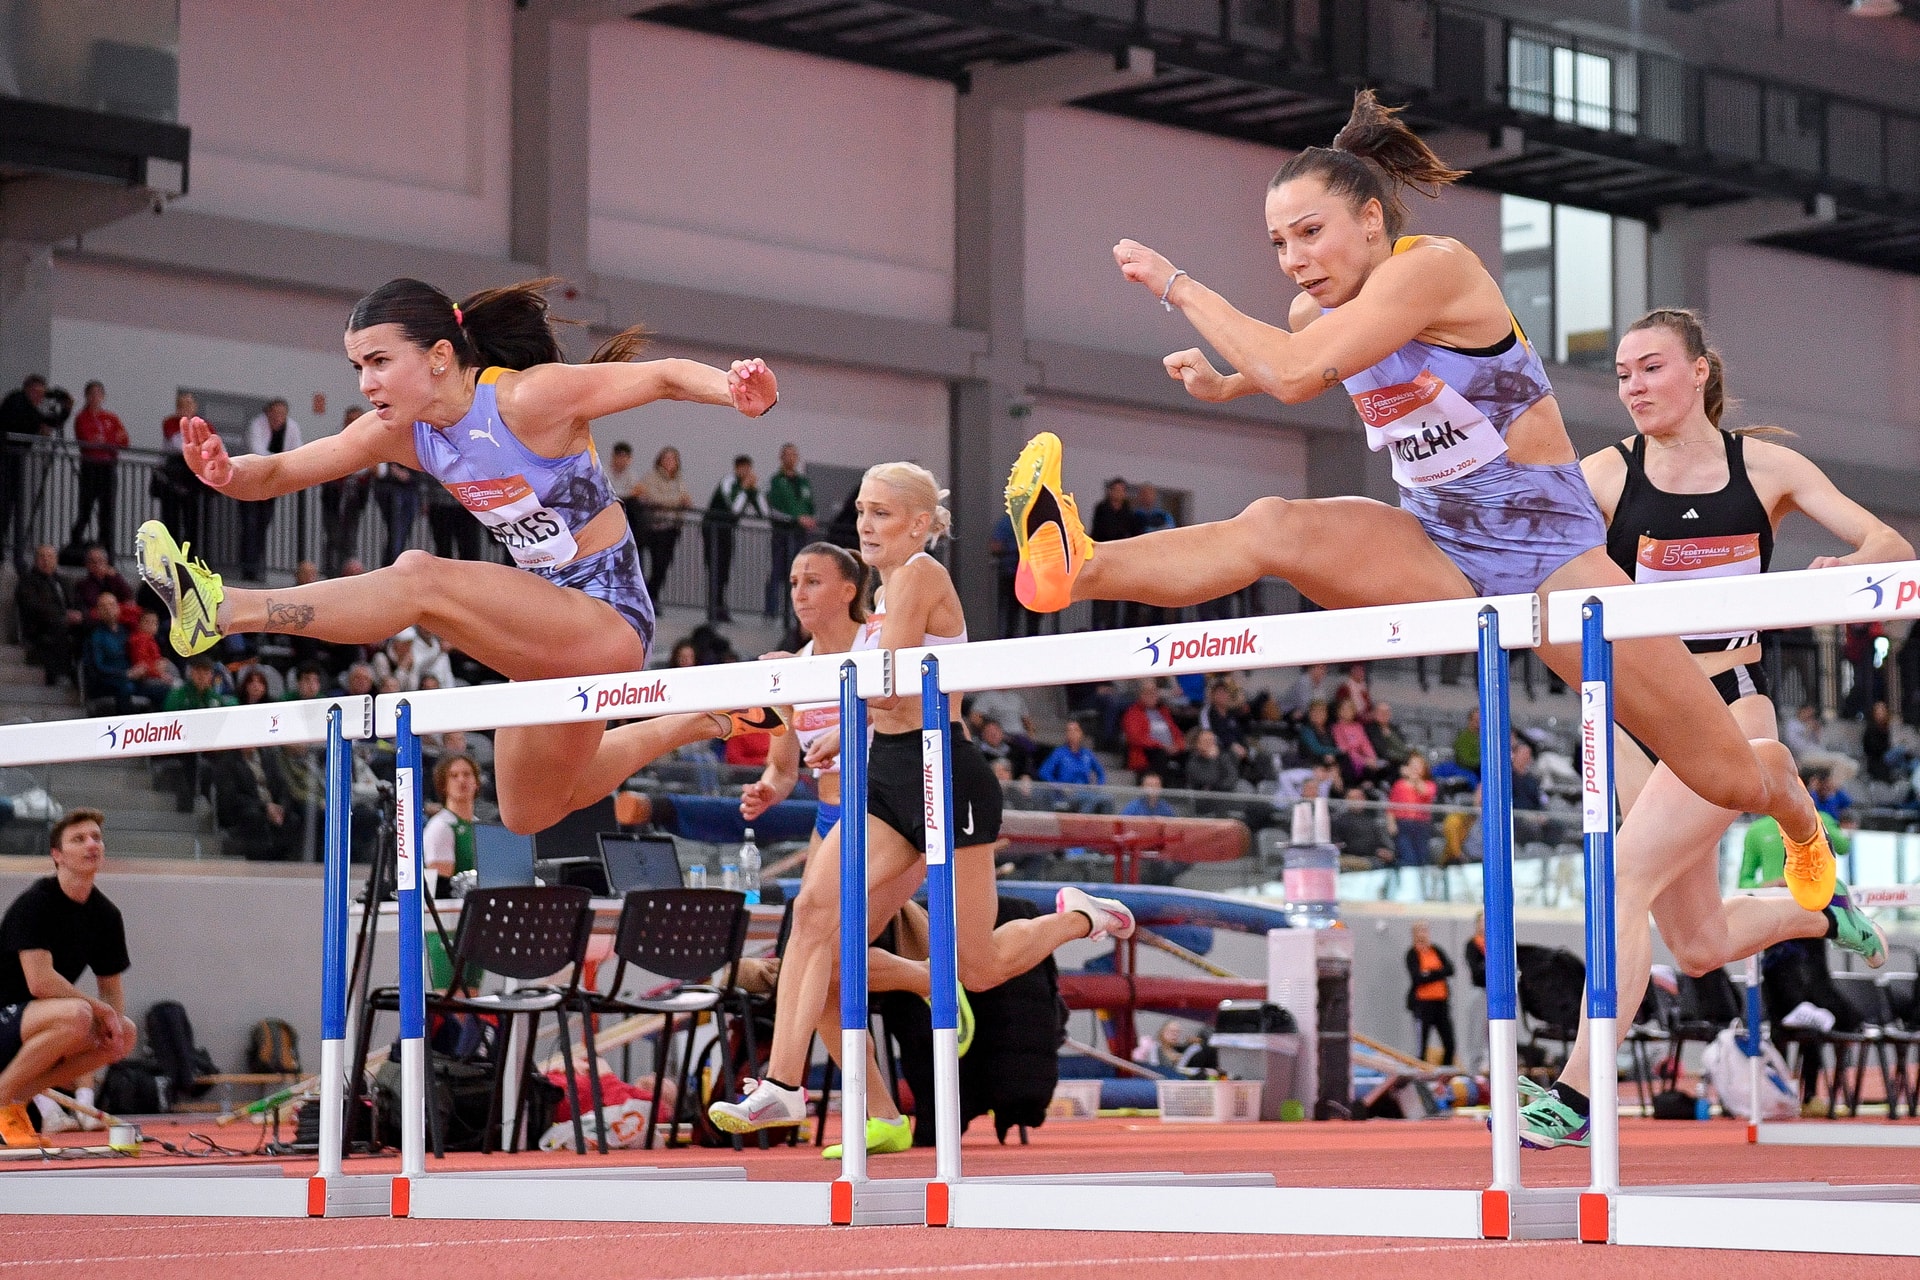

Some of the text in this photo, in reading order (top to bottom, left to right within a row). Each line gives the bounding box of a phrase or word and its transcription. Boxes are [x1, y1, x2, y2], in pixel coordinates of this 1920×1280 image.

[1456, 457, 1477, 472] 2024
[1896, 580, 1920, 610] p
[1168, 628, 1258, 667] polanik
[595, 679, 668, 713] polanik
[122, 719, 184, 750] polanik
[1582, 719, 1600, 794] polanik
[923, 763, 938, 830] polanik
[396, 798, 408, 859] polanik
